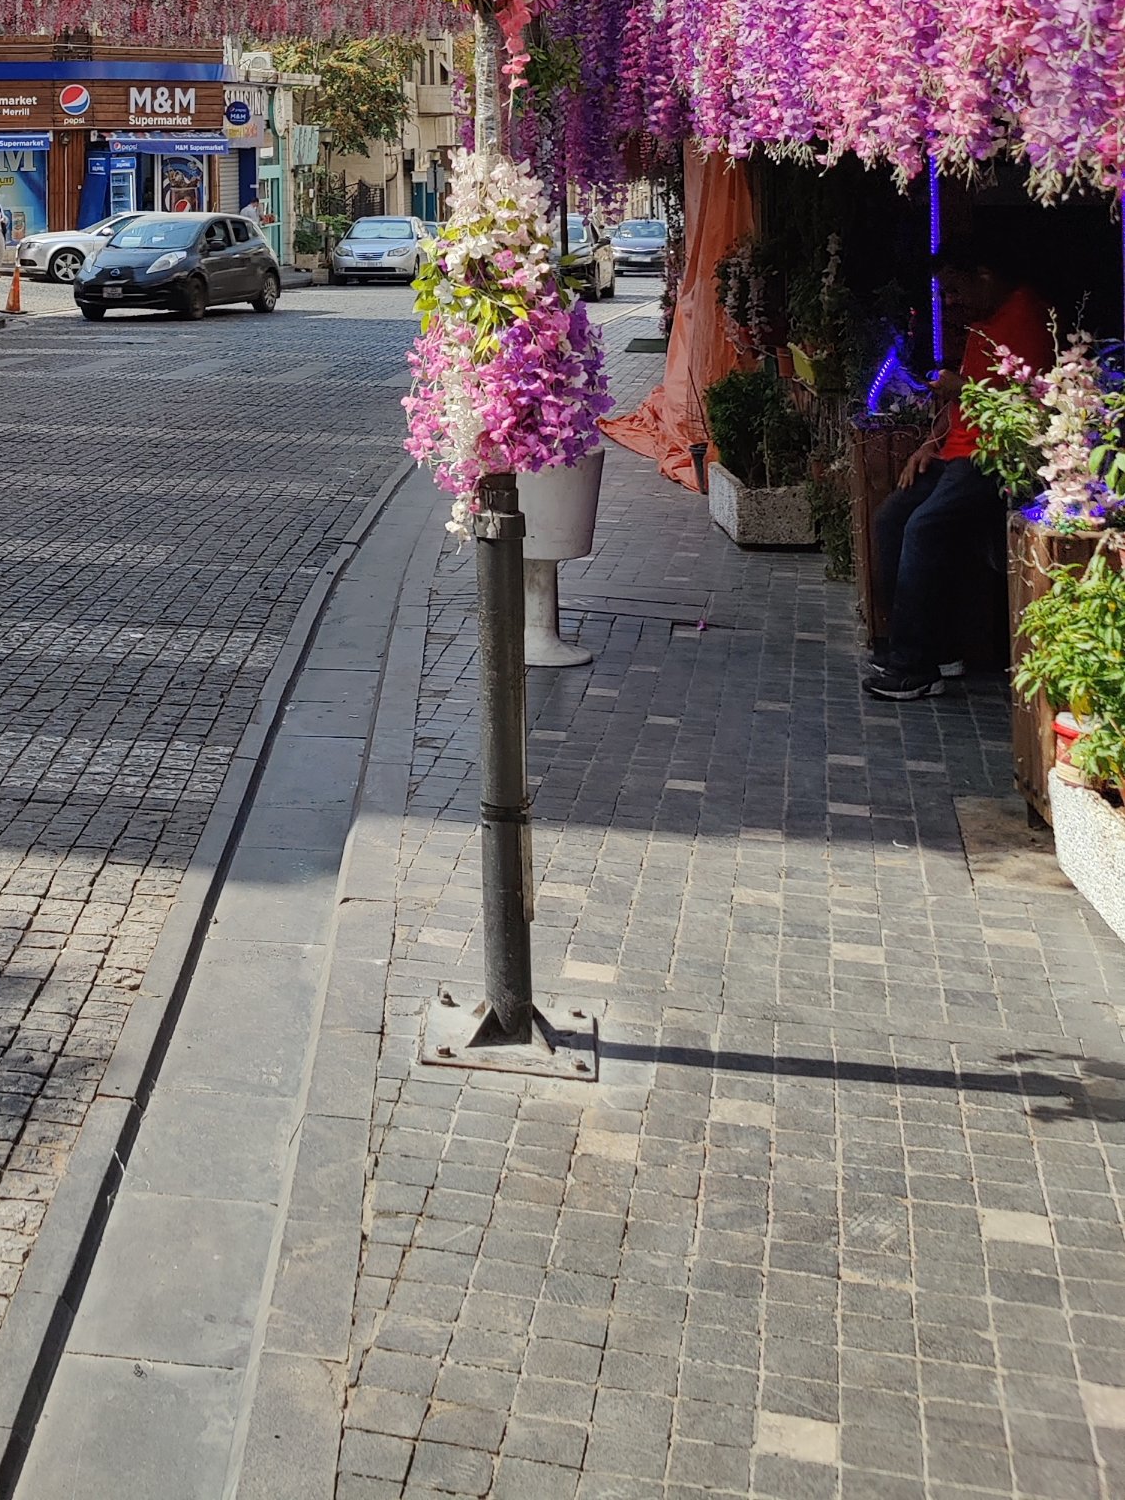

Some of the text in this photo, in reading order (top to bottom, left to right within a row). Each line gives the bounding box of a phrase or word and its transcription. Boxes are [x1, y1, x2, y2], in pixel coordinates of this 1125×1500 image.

[129, 86, 196, 114] M&M
[2, 108, 30, 116] Merrill
[63, 117, 86, 126] pepsi
[128, 115, 192, 127] Supermarket
[0, 139, 44, 148] Supermarket
[121, 143, 138, 151] pepsi
